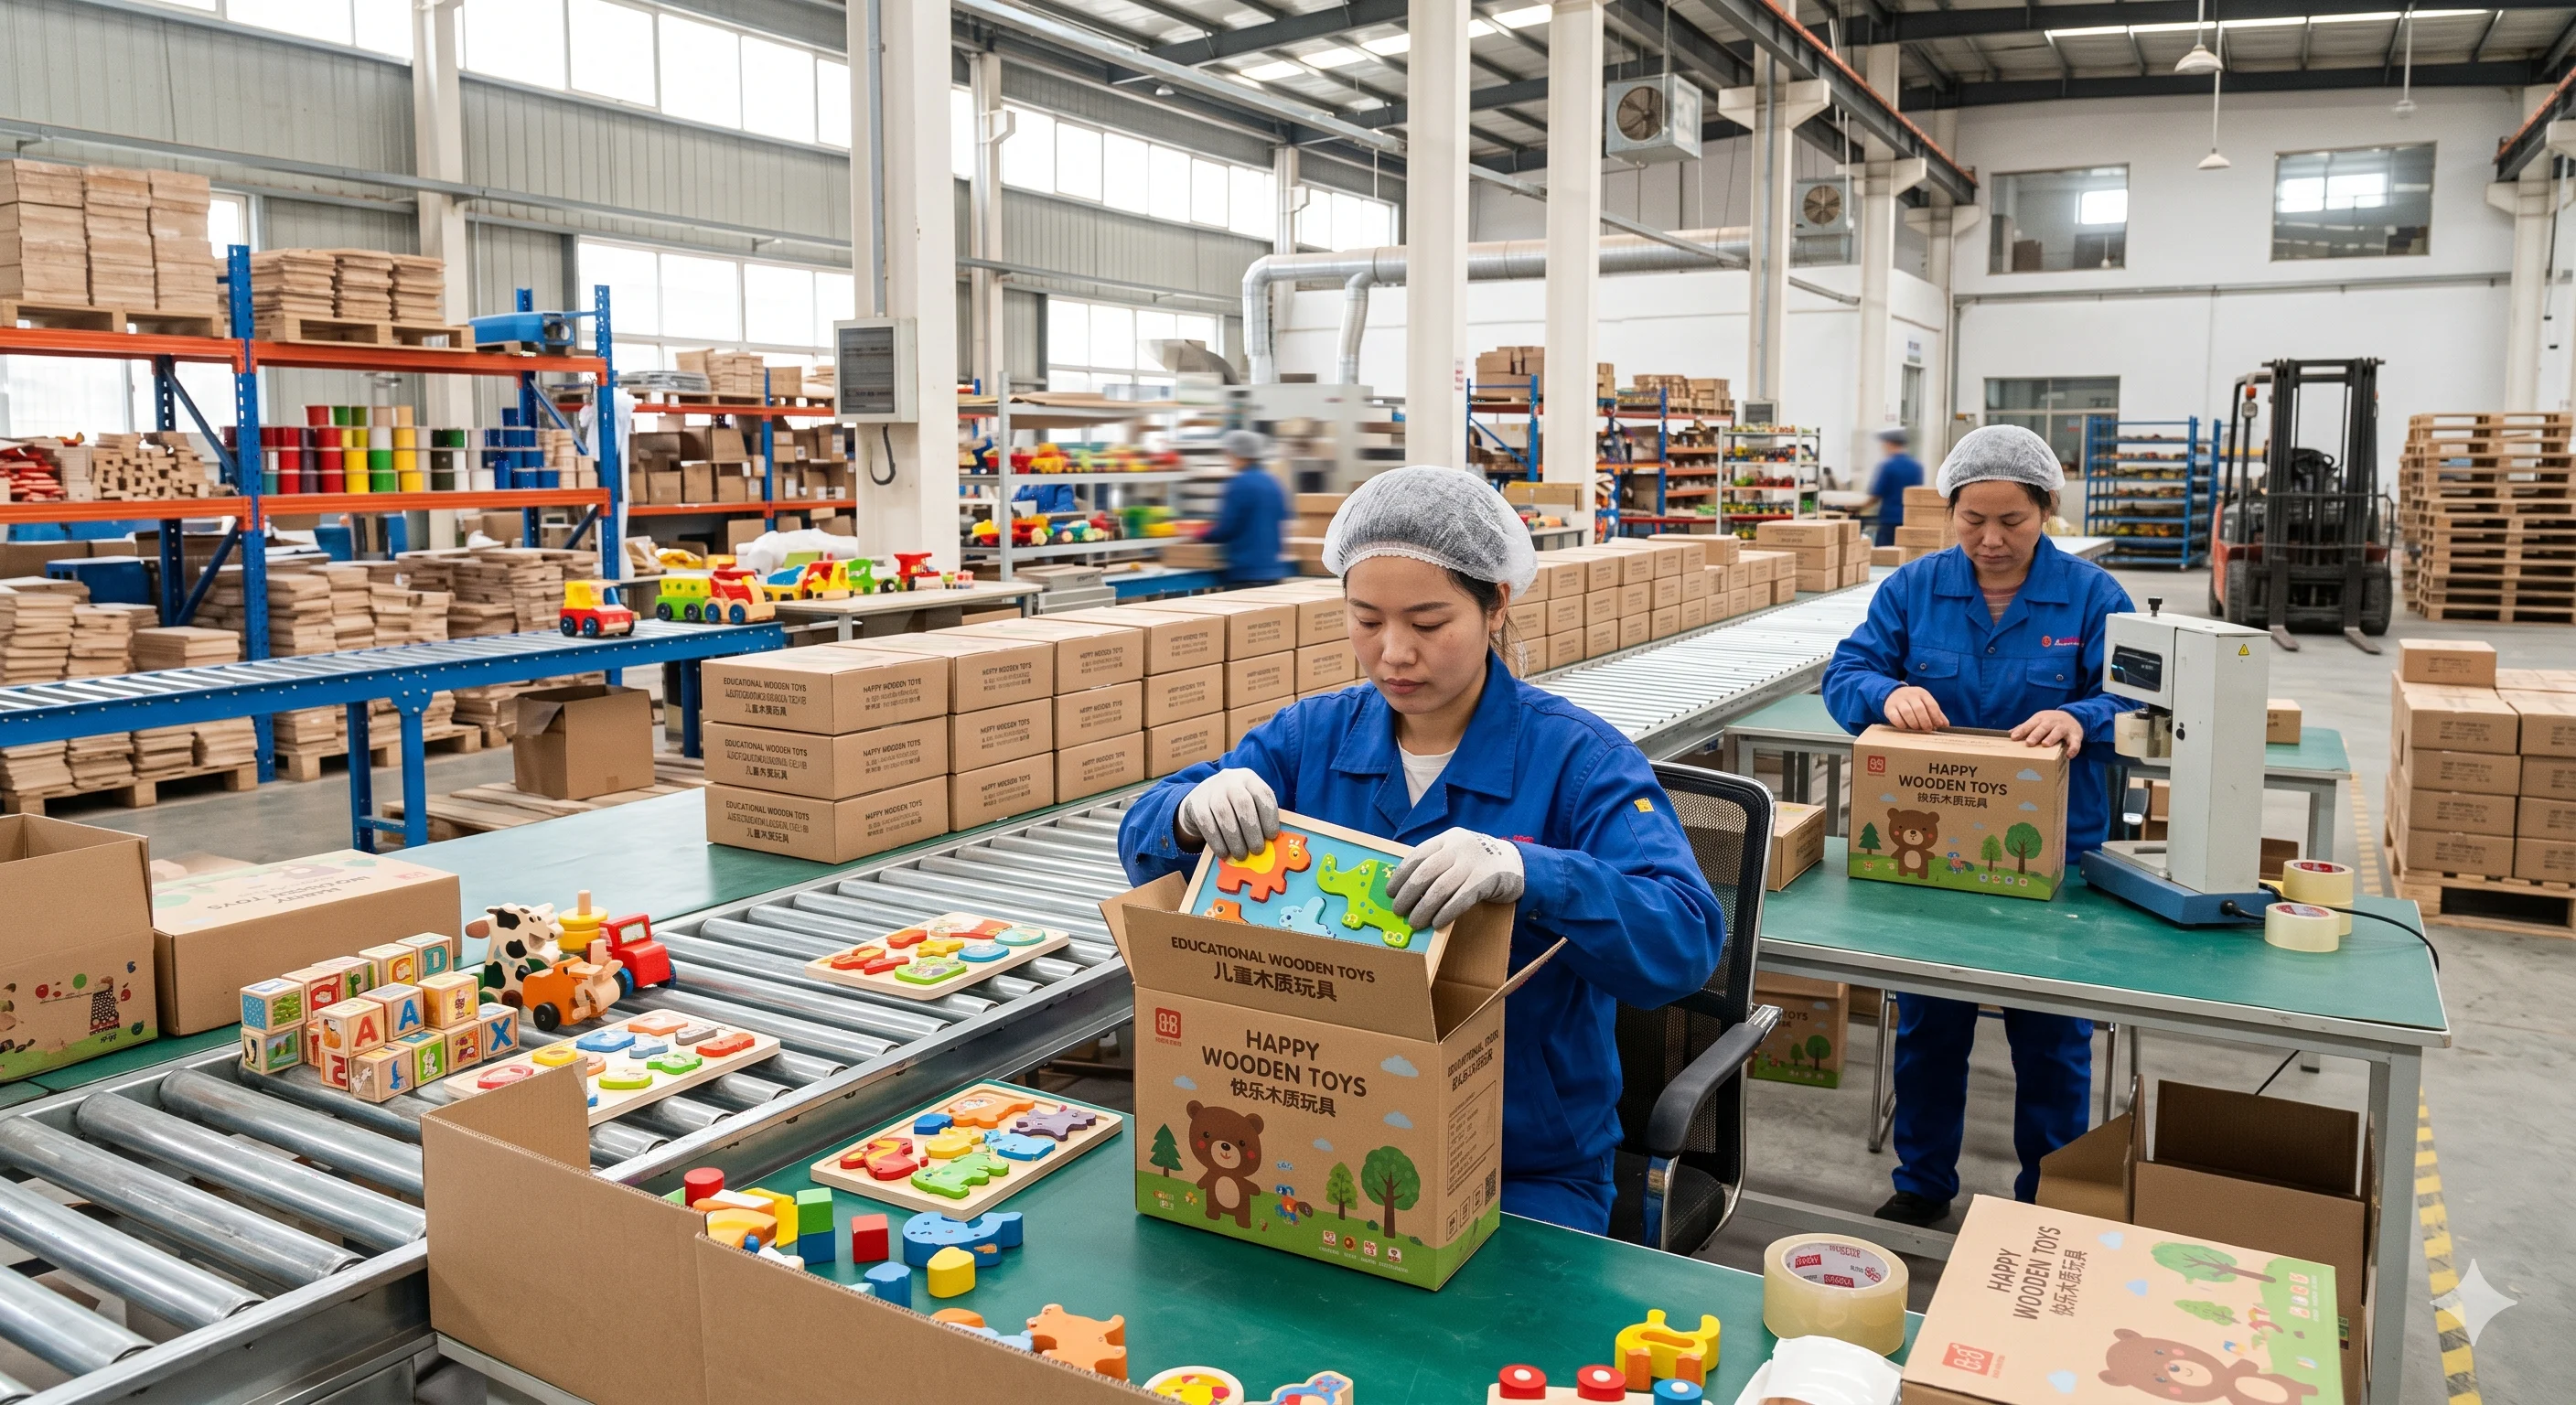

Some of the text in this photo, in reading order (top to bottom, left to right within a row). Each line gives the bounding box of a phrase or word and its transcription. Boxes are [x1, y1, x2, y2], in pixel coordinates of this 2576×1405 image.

[1898, 774, 2008, 796] WOODEN TOYS
[1928, 762, 1979, 778] HAPPY
[1171, 936, 1376, 983] EDUCATIONAL WOODEN TOYS
[1213, 961, 1337, 1003] 儿童木质玩具
[354, 1015, 379, 1047] A
[398, 999, 420, 1031] A
[490, 1017, 513, 1052] X
[1246, 1029, 1320, 1061] HAPPY
[1201, 1046, 1367, 1098] WOODEN TOYS
[1230, 1078, 1336, 1118] 快乐木质玩具
[1986, 1248, 2022, 1292] HAPPY
[2012, 1226, 2061, 1320] WOODEN TOYS
